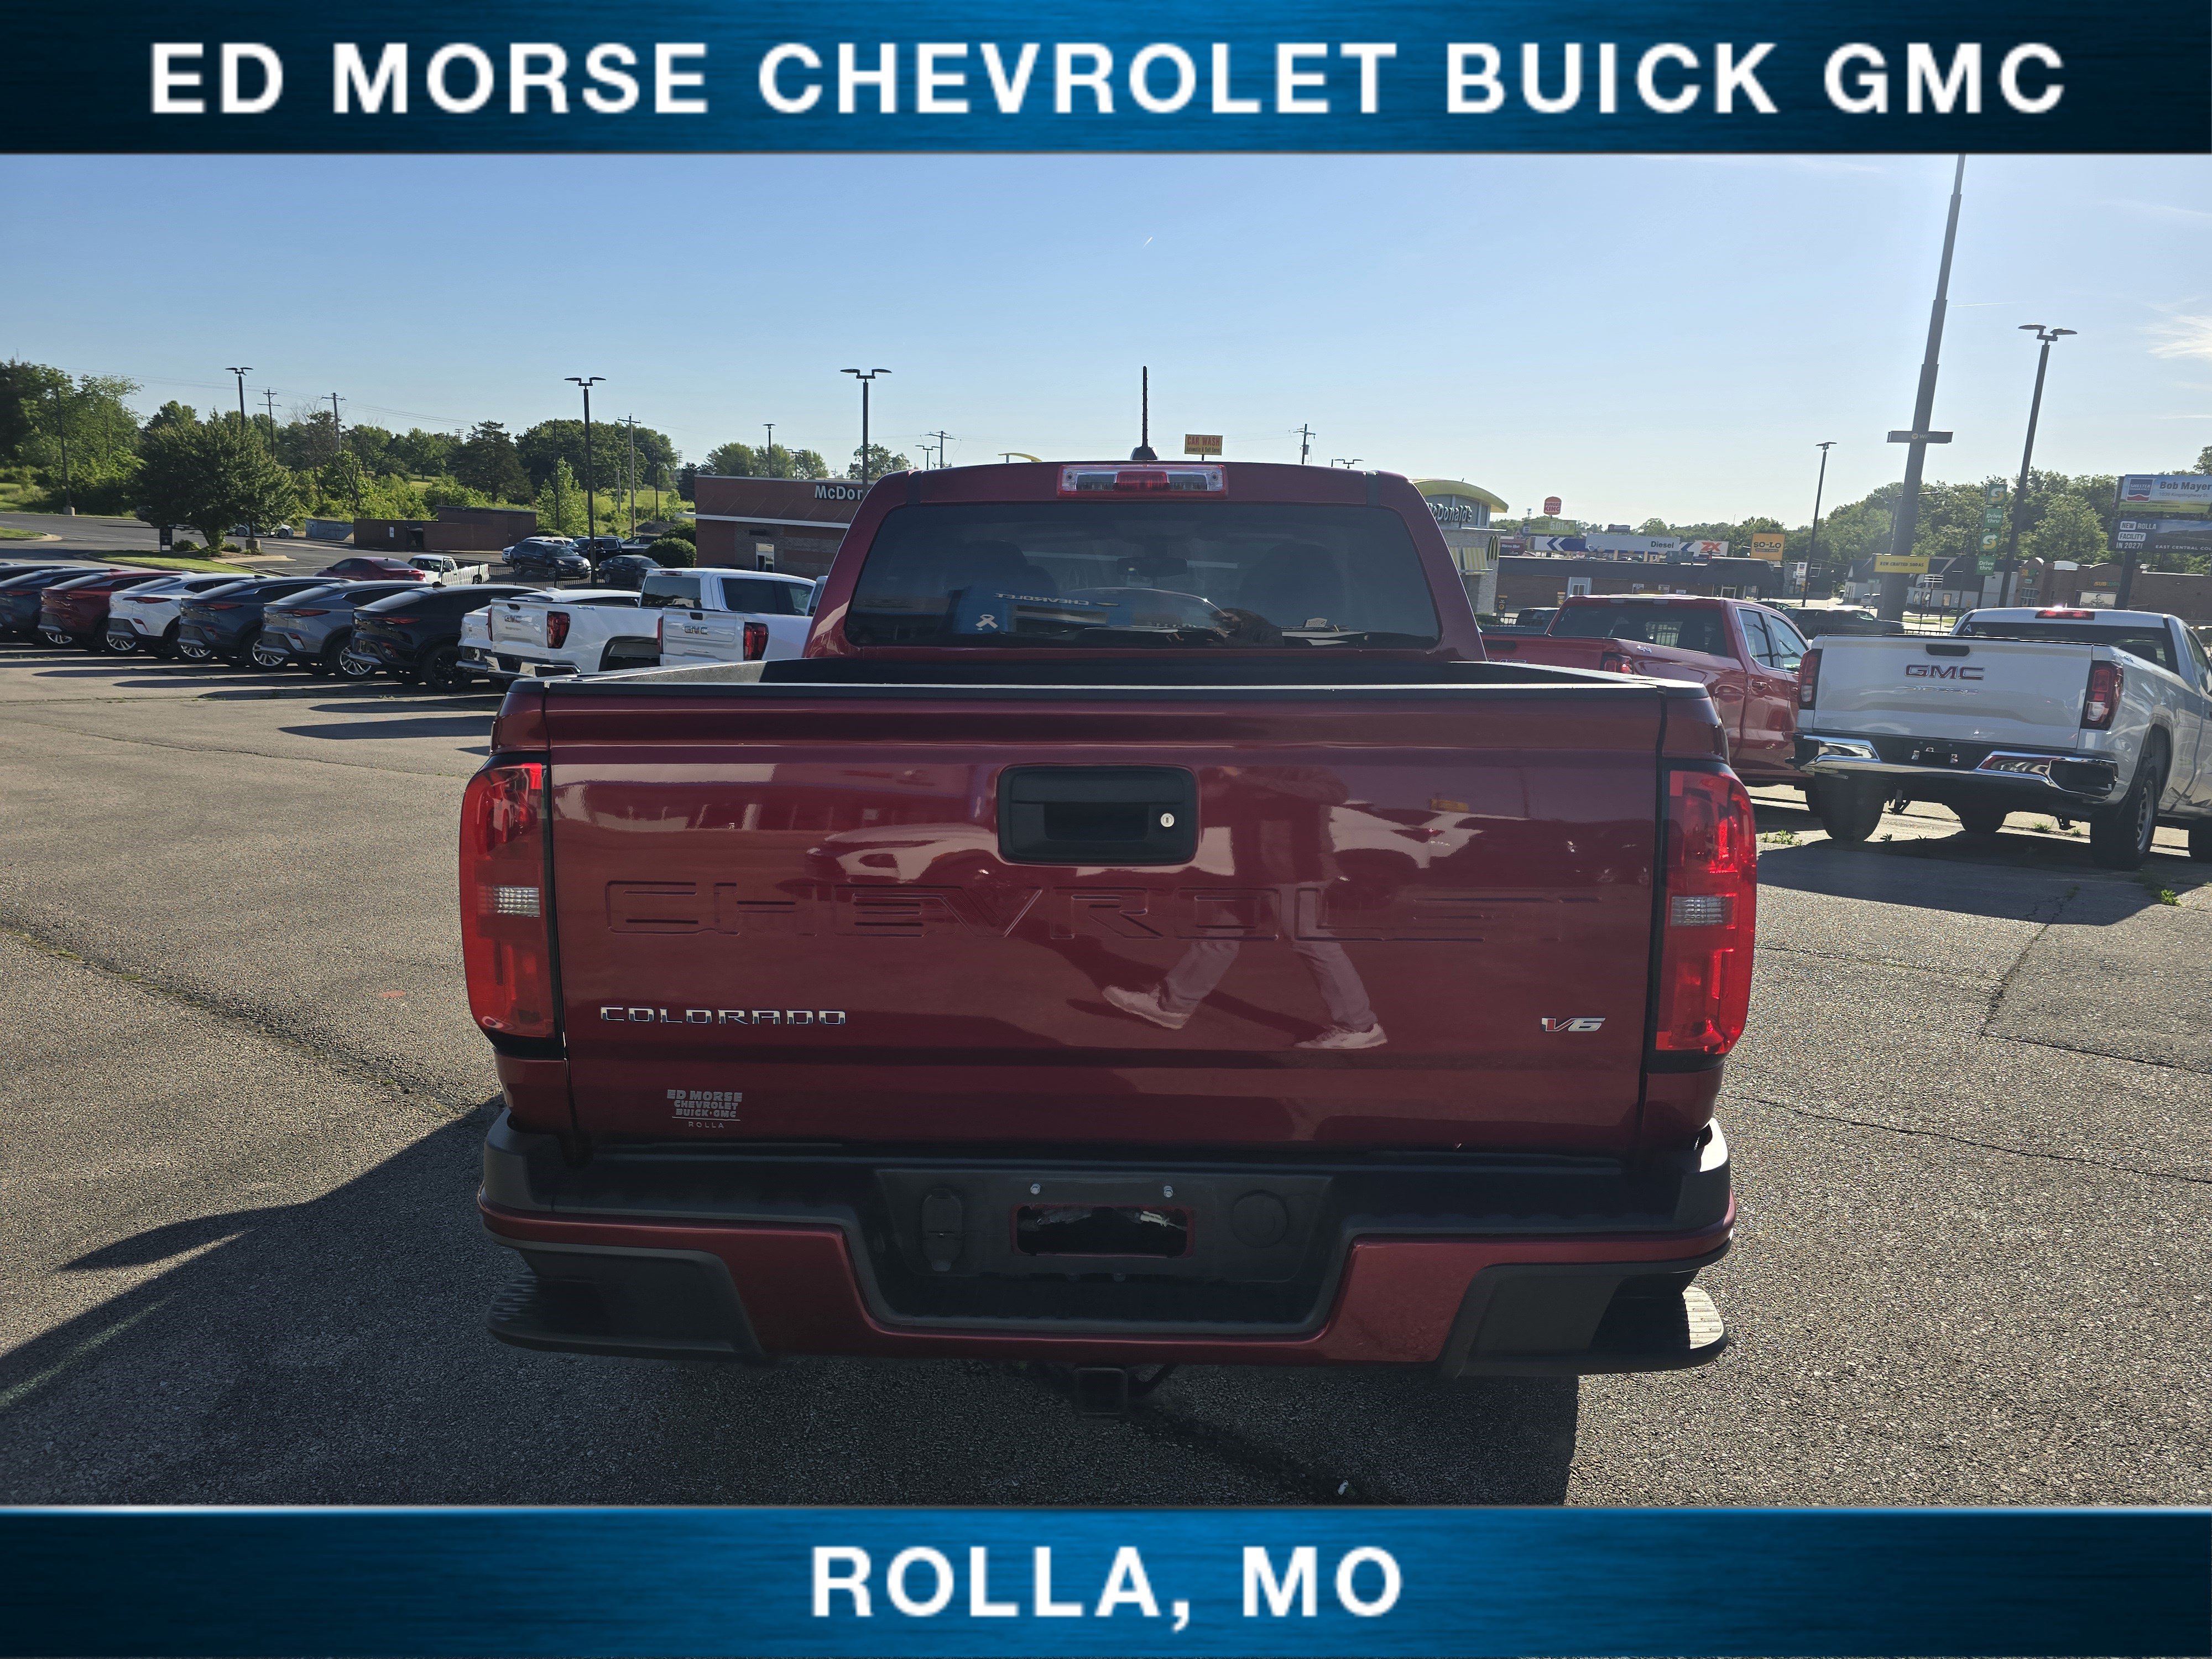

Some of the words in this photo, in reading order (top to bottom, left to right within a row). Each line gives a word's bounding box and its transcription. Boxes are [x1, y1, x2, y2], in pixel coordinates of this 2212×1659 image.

[1187, 436, 1199, 446] CAR
[1202, 437, 1220, 446] WASH
[815, 485, 870, 500] McDon
[2159, 481, 2178, 489] Bob
[2180, 482, 2212, 492] Mayer
[1700, 541, 1722, 552] ZX
[685, 625, 709, 635] GMC
[1905, 664, 1985, 681] GMC
[607, 880, 1601, 943] CHEVROLET
[600, 1006, 846, 1025] COLORADO
[1541, 1018, 1606, 1032] V6
[667, 1089, 686, 1099] ED
[690, 1090, 743, 1102] MORSE
[674, 1100, 738, 1110] CHEVROLET
[676, 1108, 708, 1117] BUICK
